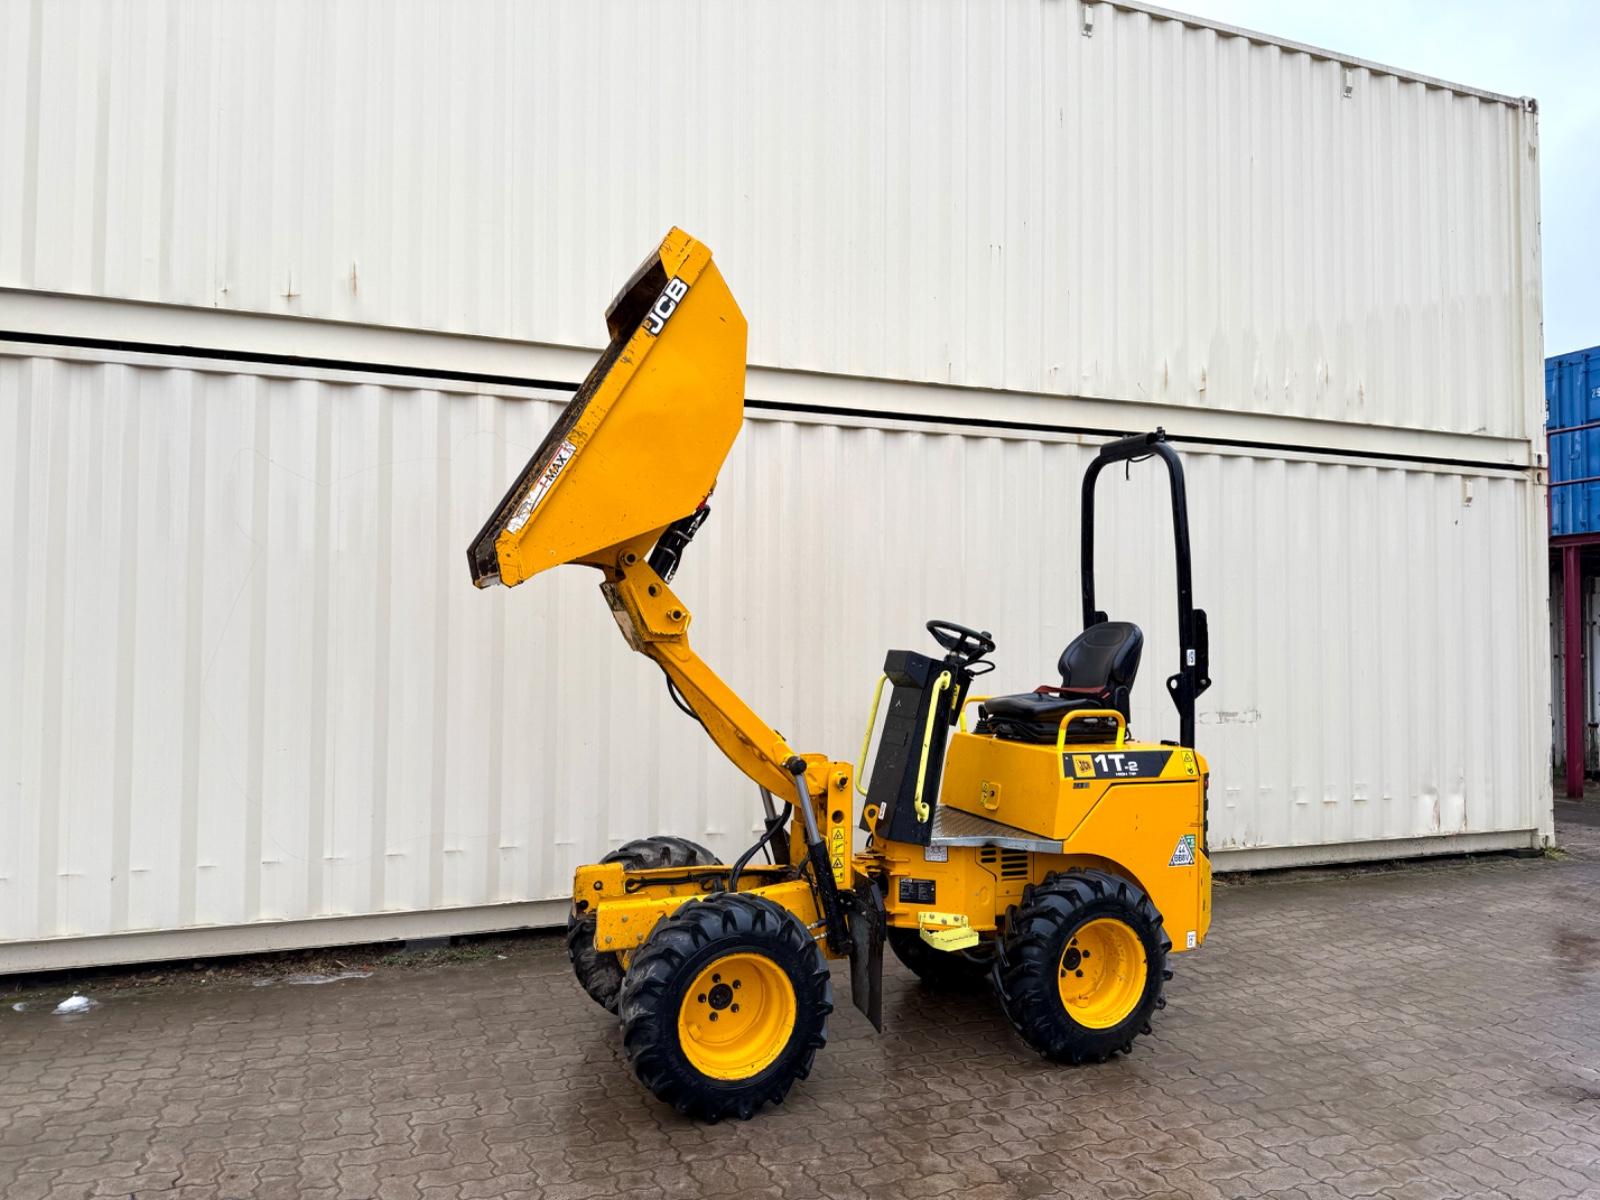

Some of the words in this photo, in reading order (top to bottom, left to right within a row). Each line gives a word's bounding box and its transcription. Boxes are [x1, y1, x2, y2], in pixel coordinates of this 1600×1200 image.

[649, 278, 689, 335] JCB
[544, 454, 568, 482] MAX
[1094, 753, 1139, 772] 1T-2
